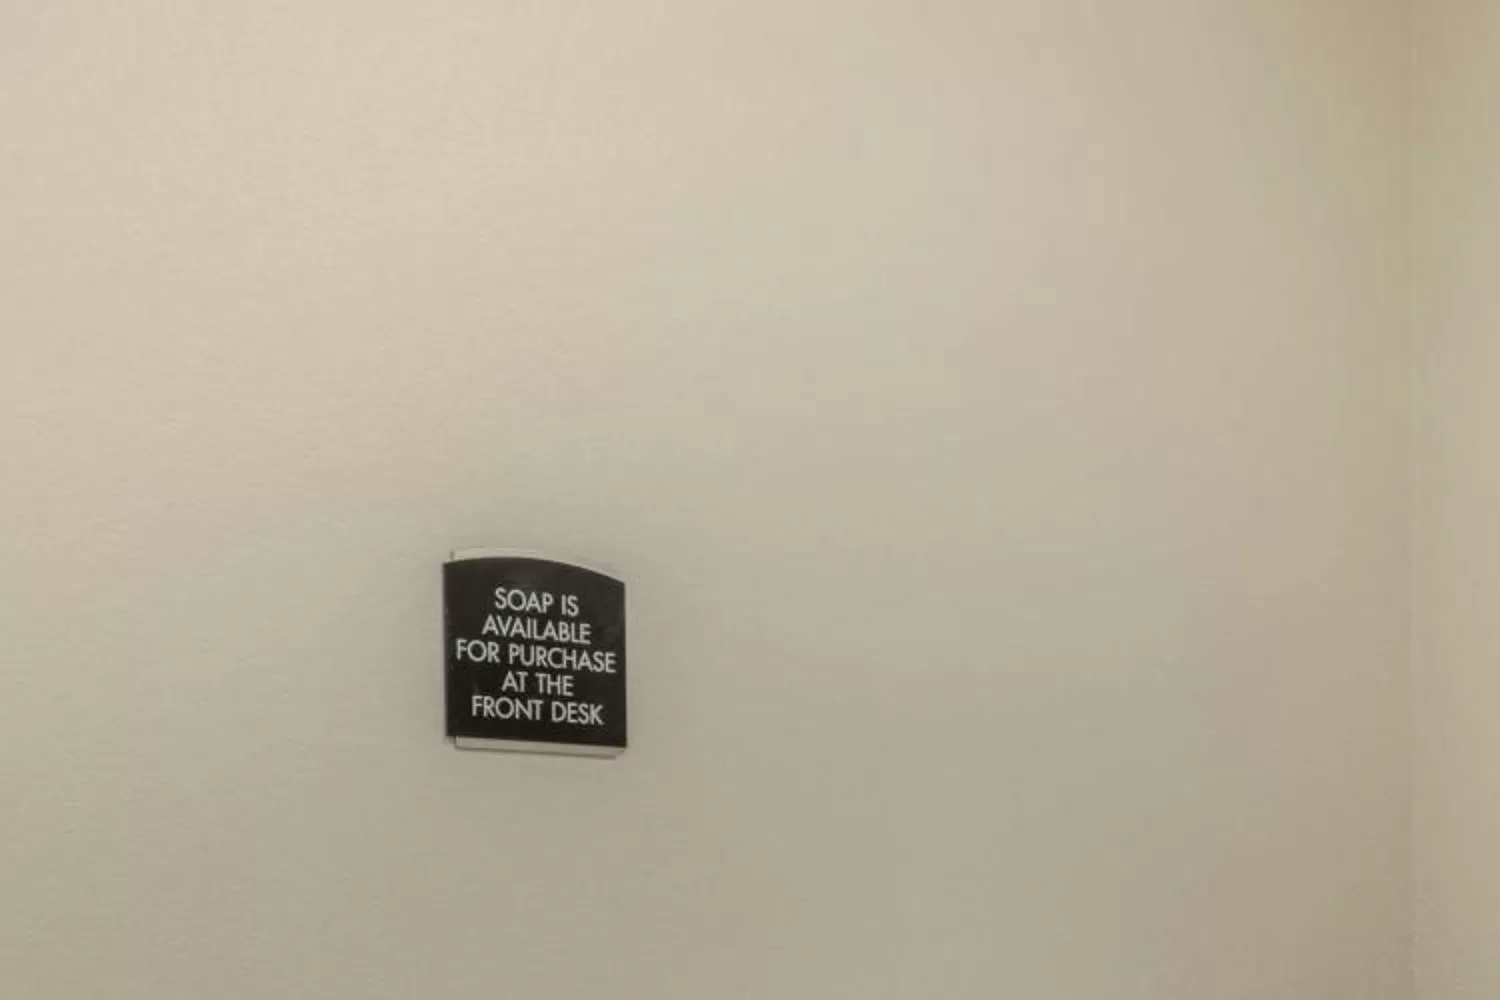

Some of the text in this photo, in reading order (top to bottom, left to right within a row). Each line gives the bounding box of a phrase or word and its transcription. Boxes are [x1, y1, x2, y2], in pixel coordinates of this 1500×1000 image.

[495, 587, 579, 617] SOAP IS
[482, 613, 592, 645] AVAILABLE
[456, 638, 617, 673] FOR PURCHASE
[501, 670, 574, 697] AT THE
[471, 695, 605, 726] FRONT DESK
